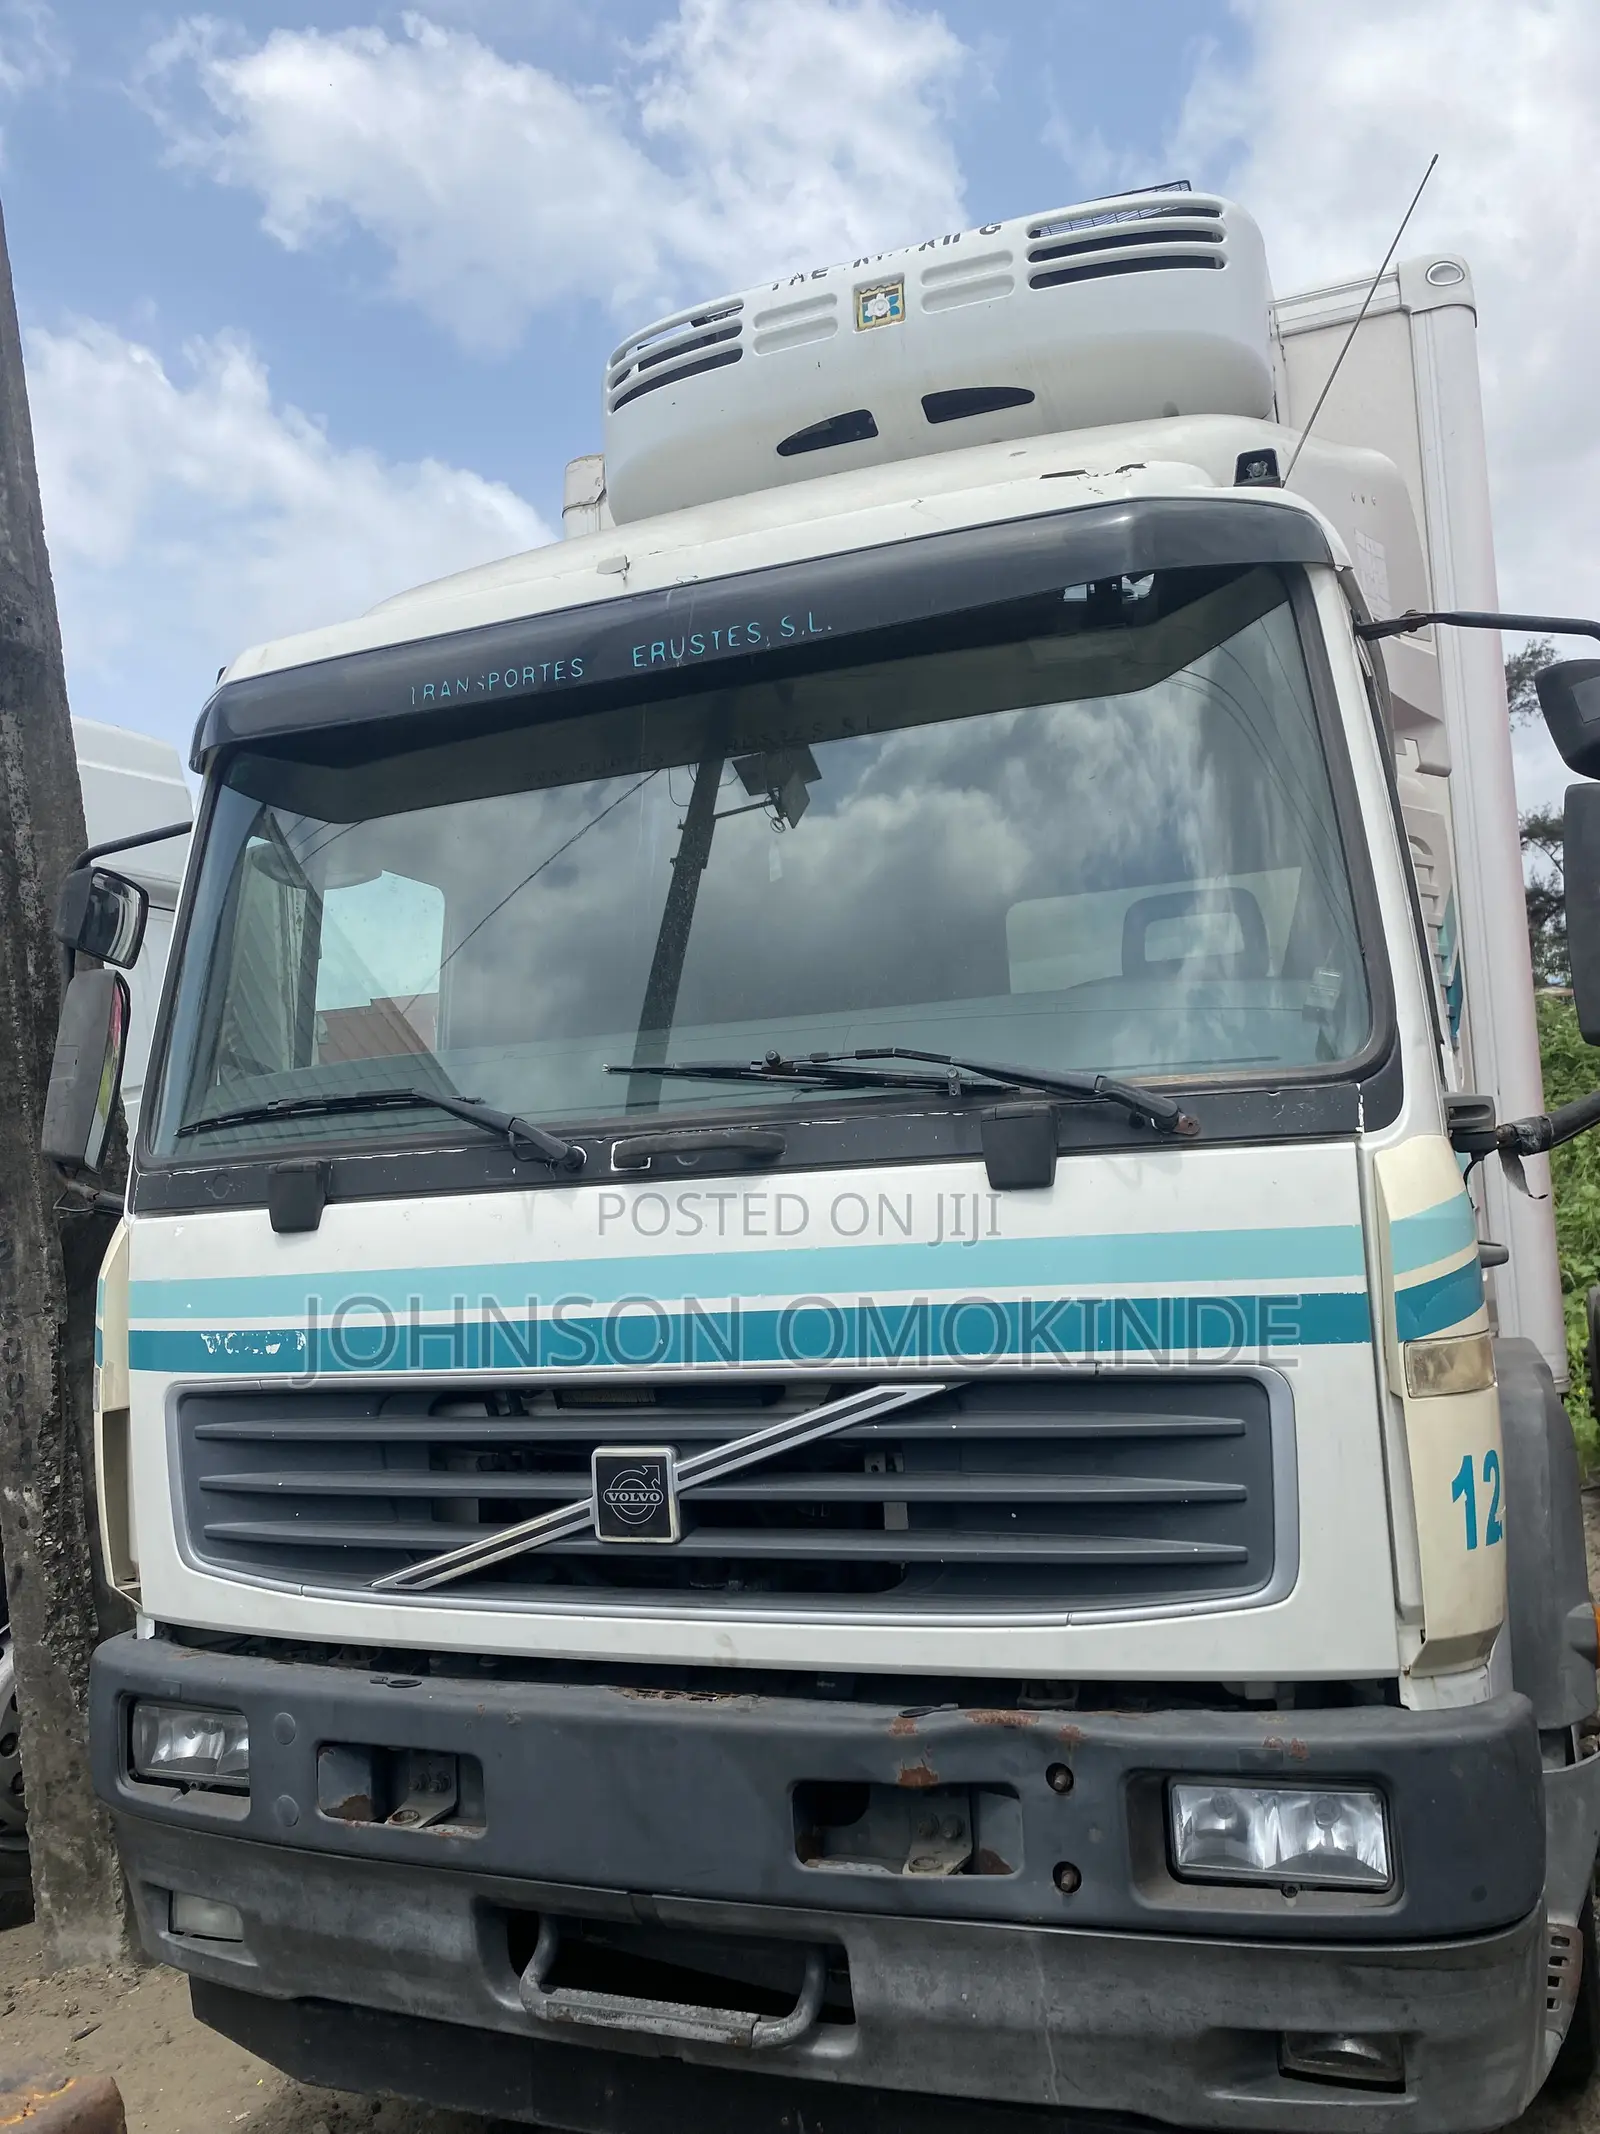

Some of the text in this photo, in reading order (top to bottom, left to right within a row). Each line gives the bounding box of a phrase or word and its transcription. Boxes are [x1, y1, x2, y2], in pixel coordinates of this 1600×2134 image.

[780, 611, 833, 638] S.L.
[606, 1491, 661, 1502] VOLVO
[1451, 1449, 1503, 1551] 12
